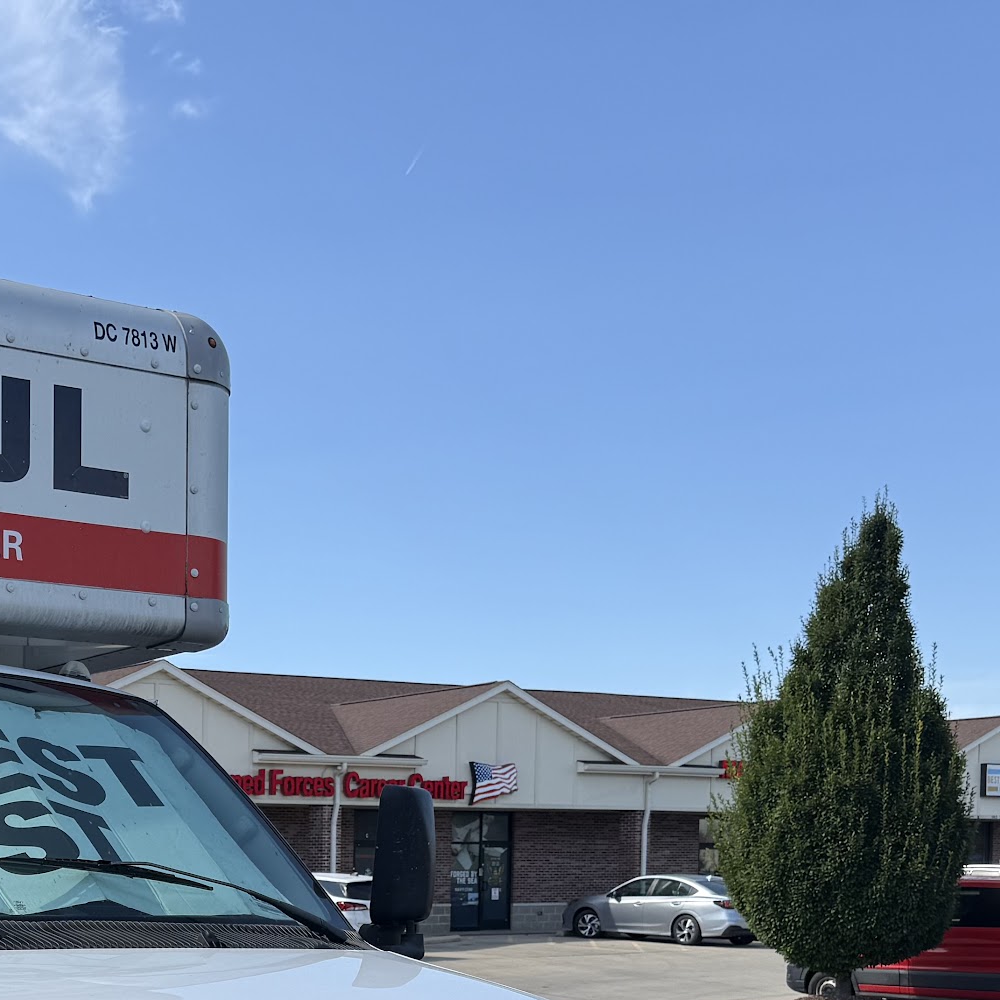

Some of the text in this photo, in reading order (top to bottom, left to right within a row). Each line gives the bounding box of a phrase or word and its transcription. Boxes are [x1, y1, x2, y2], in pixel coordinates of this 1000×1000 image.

[93, 321, 177, 353] DC 7813 W
[269, 769, 335, 797] Forces
